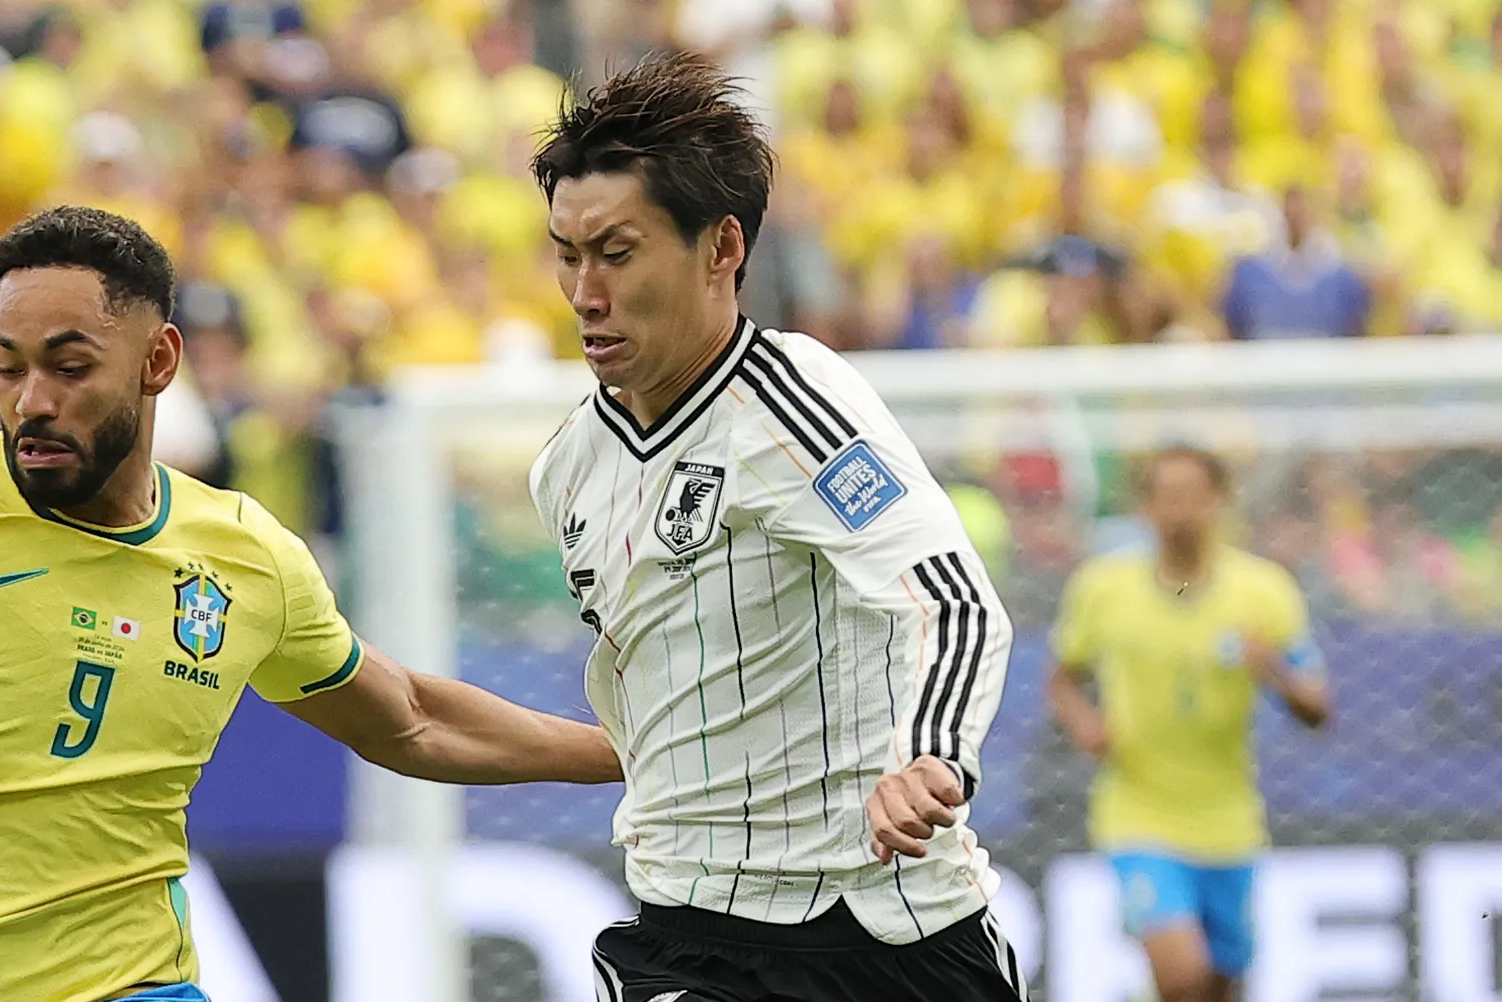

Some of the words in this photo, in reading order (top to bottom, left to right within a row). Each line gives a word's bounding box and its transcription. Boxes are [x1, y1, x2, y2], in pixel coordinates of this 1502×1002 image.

[685, 463, 714, 475] JAPAN
[827, 456, 867, 493] FOOTBALL
[835, 464, 876, 504] UNITES
[858, 473, 888, 503] World
[666, 523, 693, 541] JFA
[191, 608, 212, 623] CBF
[164, 660, 220, 690] BRASIL
[50, 660, 115, 759] 9
